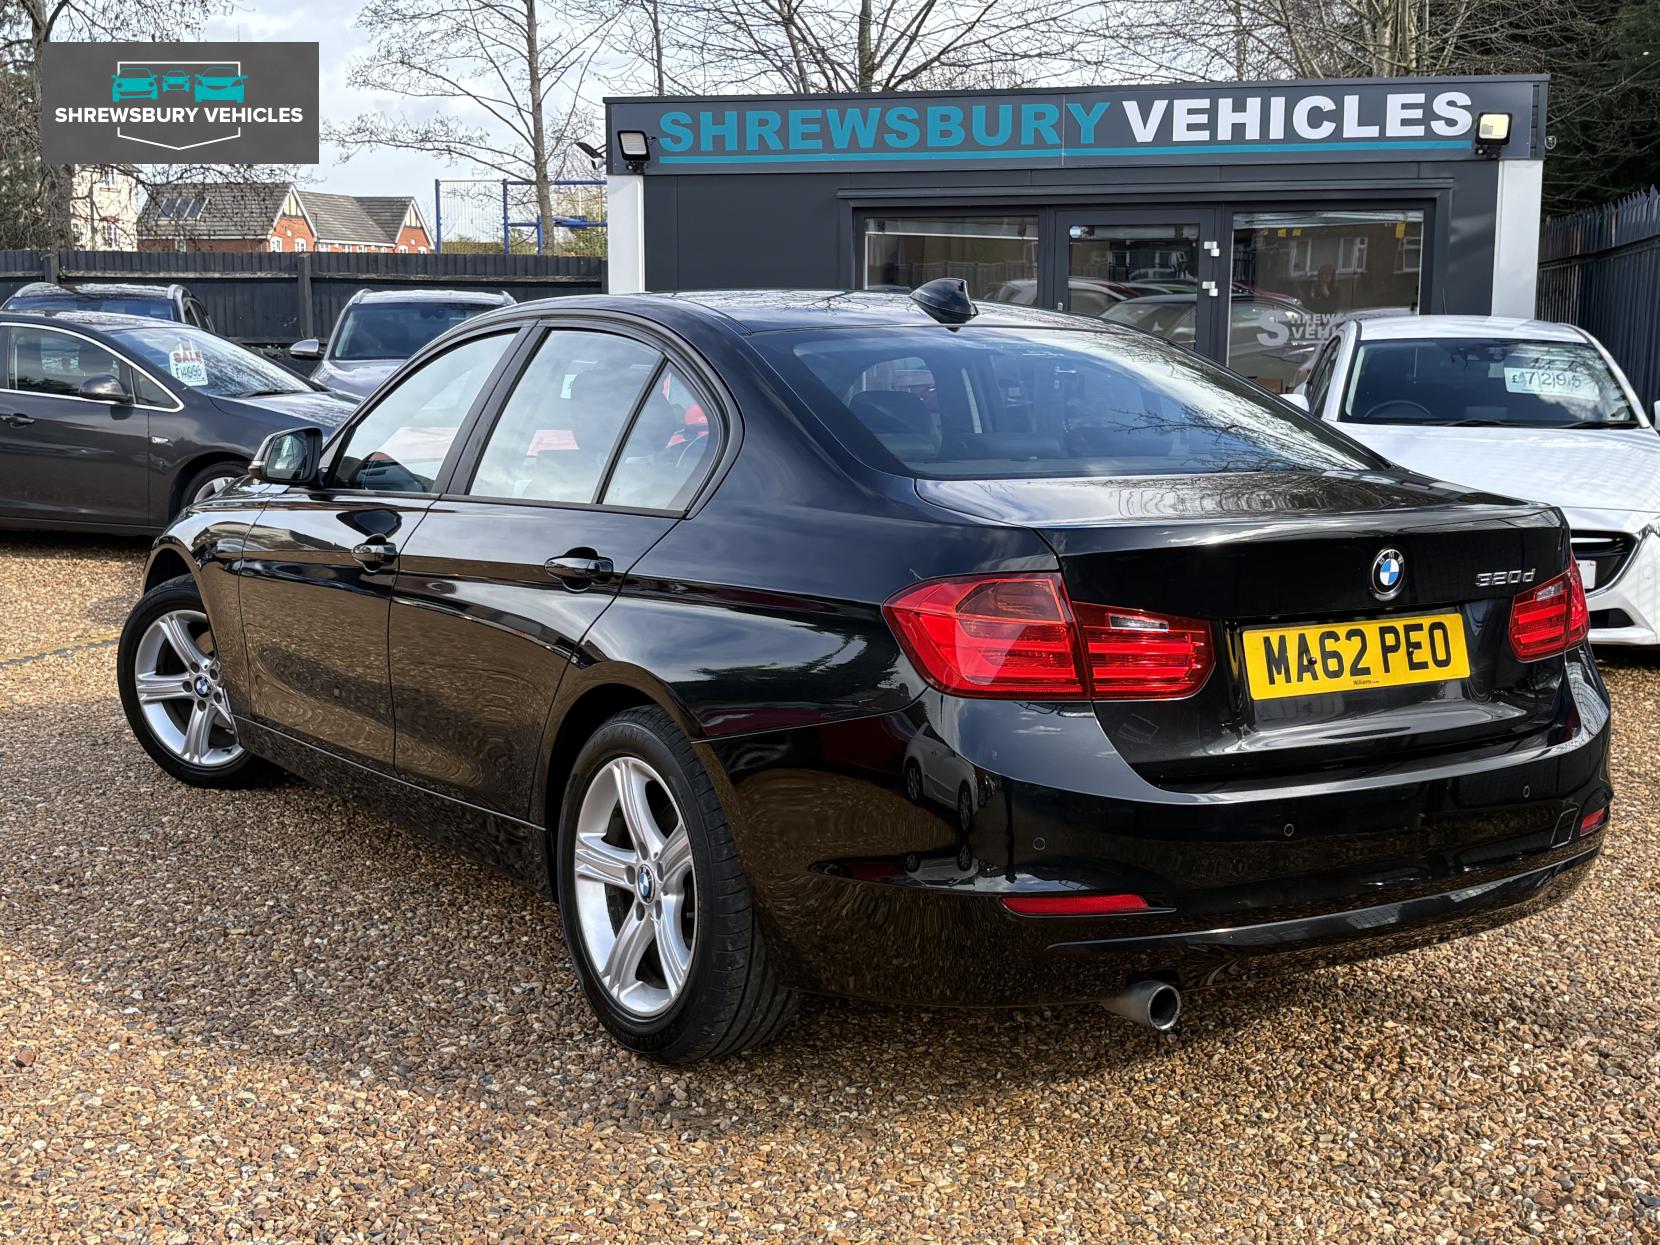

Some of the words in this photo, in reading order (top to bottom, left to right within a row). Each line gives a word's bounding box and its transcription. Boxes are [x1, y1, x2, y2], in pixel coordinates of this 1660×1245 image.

[659, 102, 1111, 152] SHREWSBURY
[1122, 91, 1473, 143] VEHICLES
[173, 351, 203, 363] SALE
[1475, 567, 1537, 588] 320d
[1262, 627, 1372, 686] MA62
[1378, 621, 1452, 674] PEO
